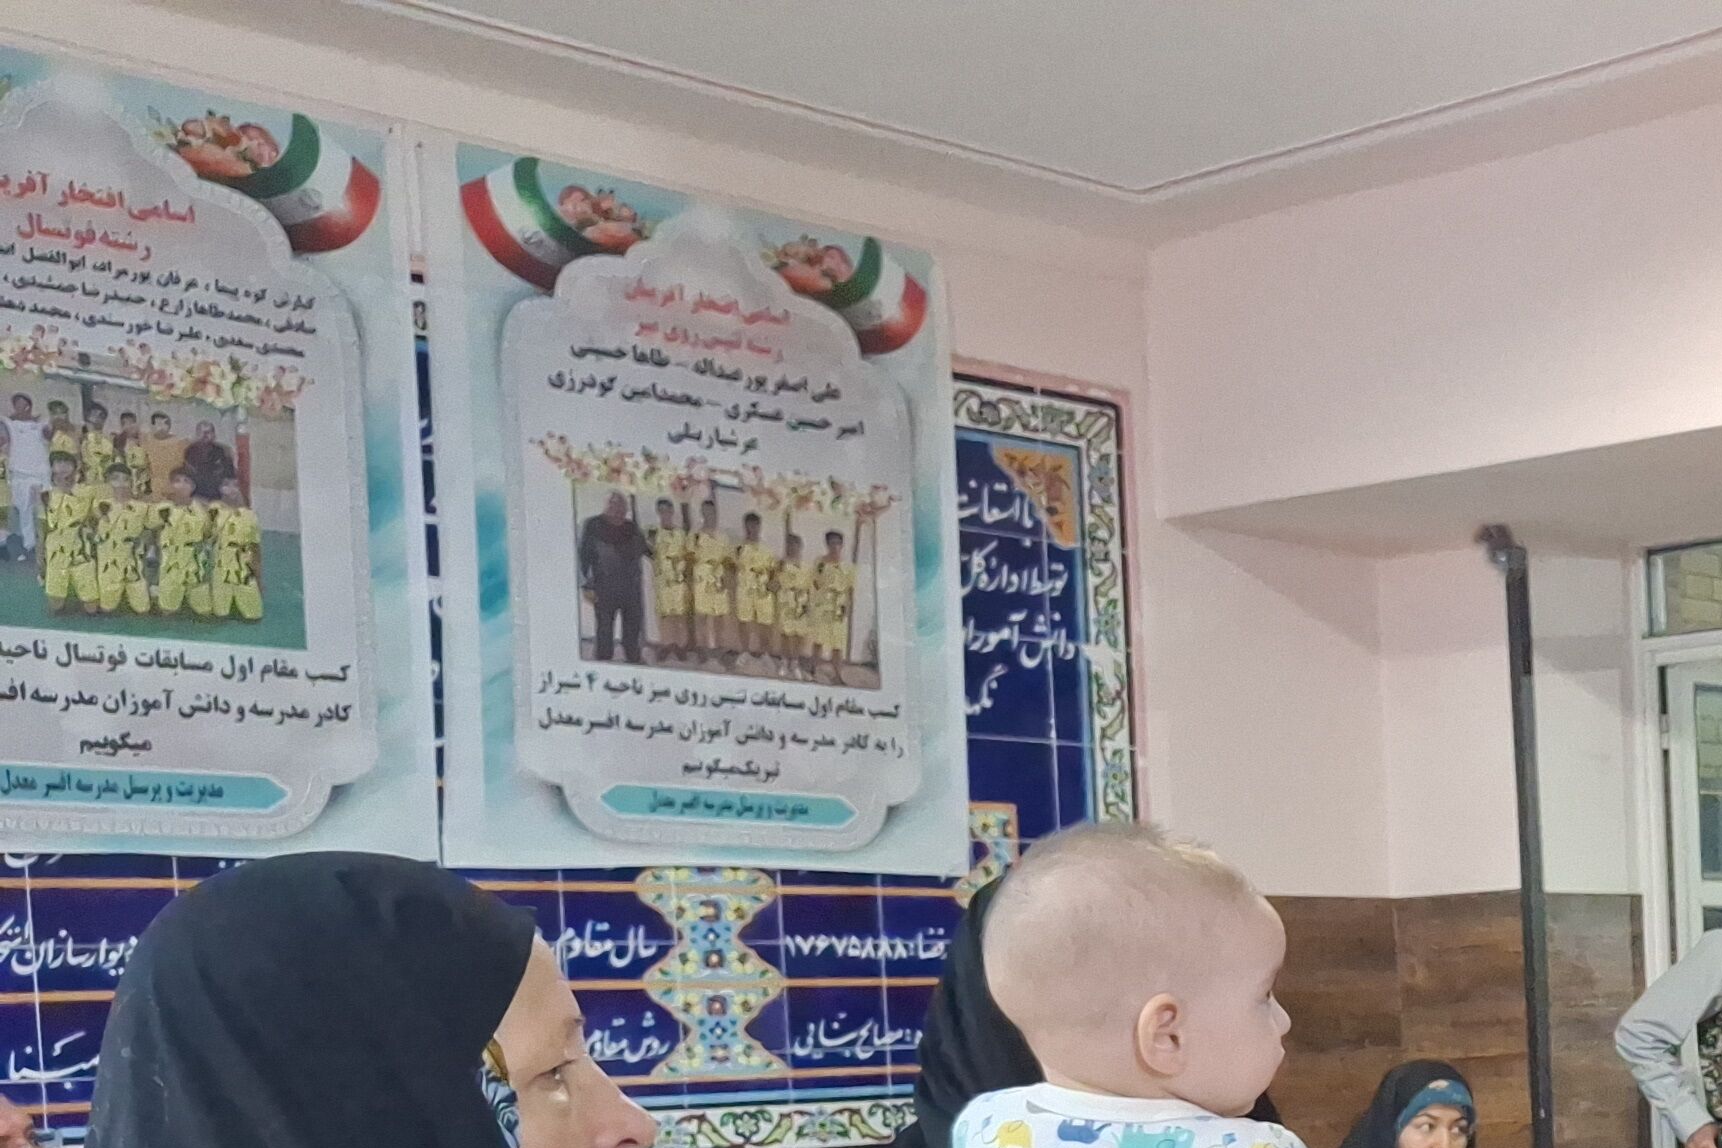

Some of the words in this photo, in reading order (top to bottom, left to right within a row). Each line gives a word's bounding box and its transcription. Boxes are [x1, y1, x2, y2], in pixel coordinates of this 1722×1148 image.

[57, 180, 125, 209] افتخار
[127, 198, 196, 224] اسامی
[17, 212, 97, 249] فوتسال
[99, 230, 152, 262] رشته
[56, 642, 128, 672] فوتسال
[135, 648, 214, 677] مسابقات
[221, 654, 255, 683] اول
[260, 658, 300, 684] مقام
[304, 664, 352, 688] کسب
[30, 686, 100, 712] مدرسه
[102, 688, 175, 717] آموزان
[178, 692, 232, 719] دانش
[234, 704, 246, 723] و
[248, 701, 311, 726] مدرسه
[313, 703, 353, 728] کادر
